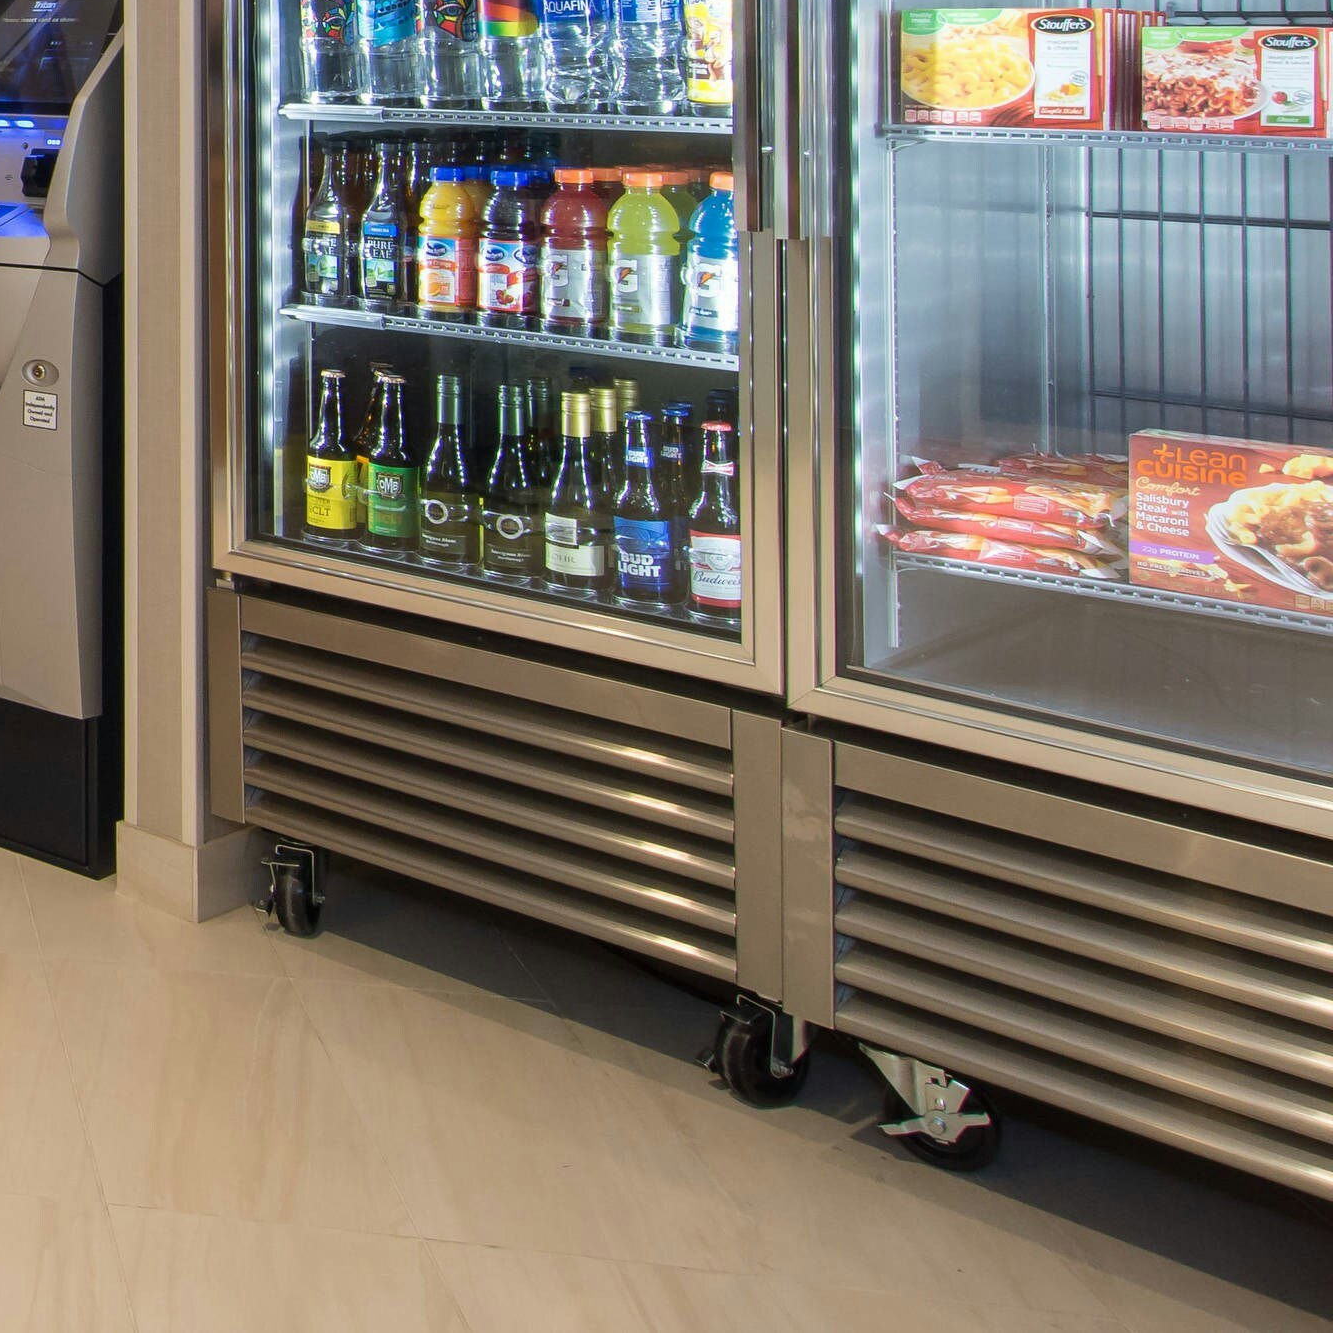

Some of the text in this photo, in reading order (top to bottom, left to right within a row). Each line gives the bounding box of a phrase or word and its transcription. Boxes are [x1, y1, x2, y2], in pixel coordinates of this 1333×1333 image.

[544, 0, 595, 14] AQUAFINA
[1038, 17, 1087, 31] Stouffer's
[1265, 37, 1312, 48] Stouffer's
[367, 240, 394, 249] PURE
[27, 408, 43, 416] Owned
[625, 455, 649, 464] LIGHT
[661, 451, 683, 459] LIGHT
[1176, 448, 1246, 470] Lean
[1135, 476, 1201, 496] Comfort
[1136, 492, 1190, 509] Salisbury
[1136, 502, 1189, 517] Steak with
[1136, 512, 1189, 527] Macaroni
[1136, 521, 1190, 537] & Cheese
[620, 553, 654, 565] BUD
[1159, 547, 1201, 560] PROTEIN
[618, 560, 662, 577] LIGHT
